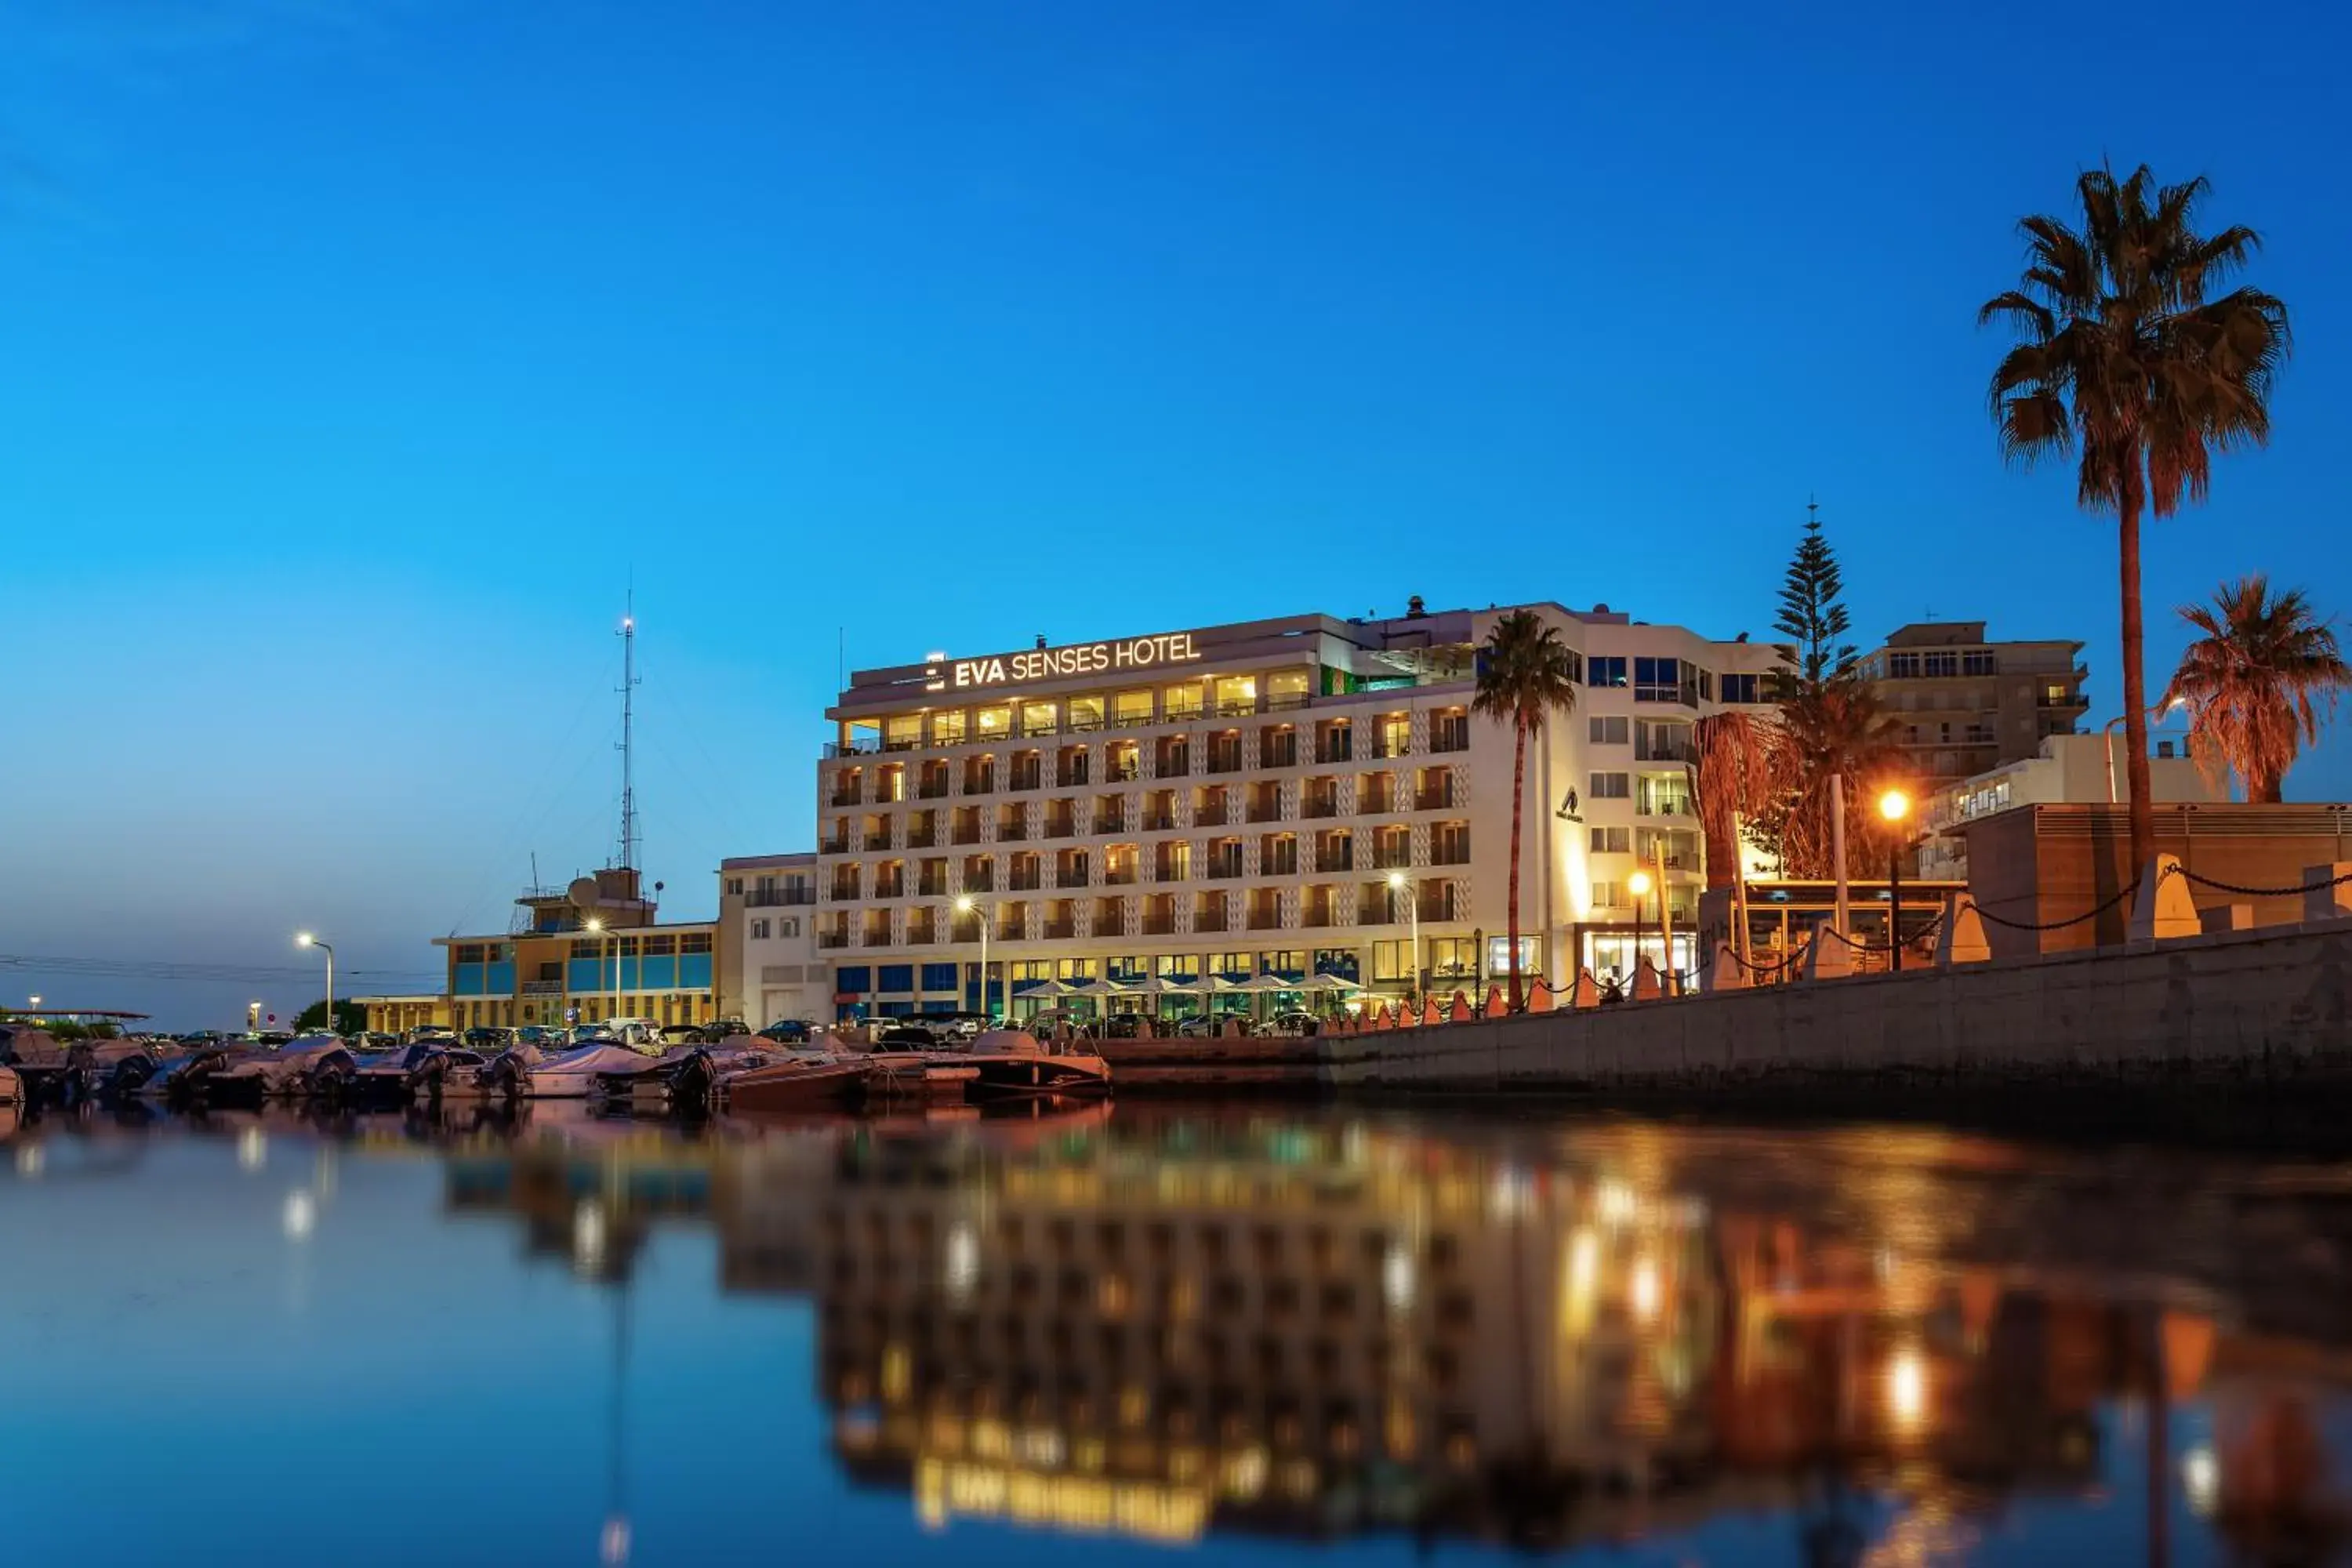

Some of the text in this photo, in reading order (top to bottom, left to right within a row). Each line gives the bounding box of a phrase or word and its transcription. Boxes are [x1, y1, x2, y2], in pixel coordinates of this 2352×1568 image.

[956, 634, 1201, 687] EVA SENSES HOTEL
